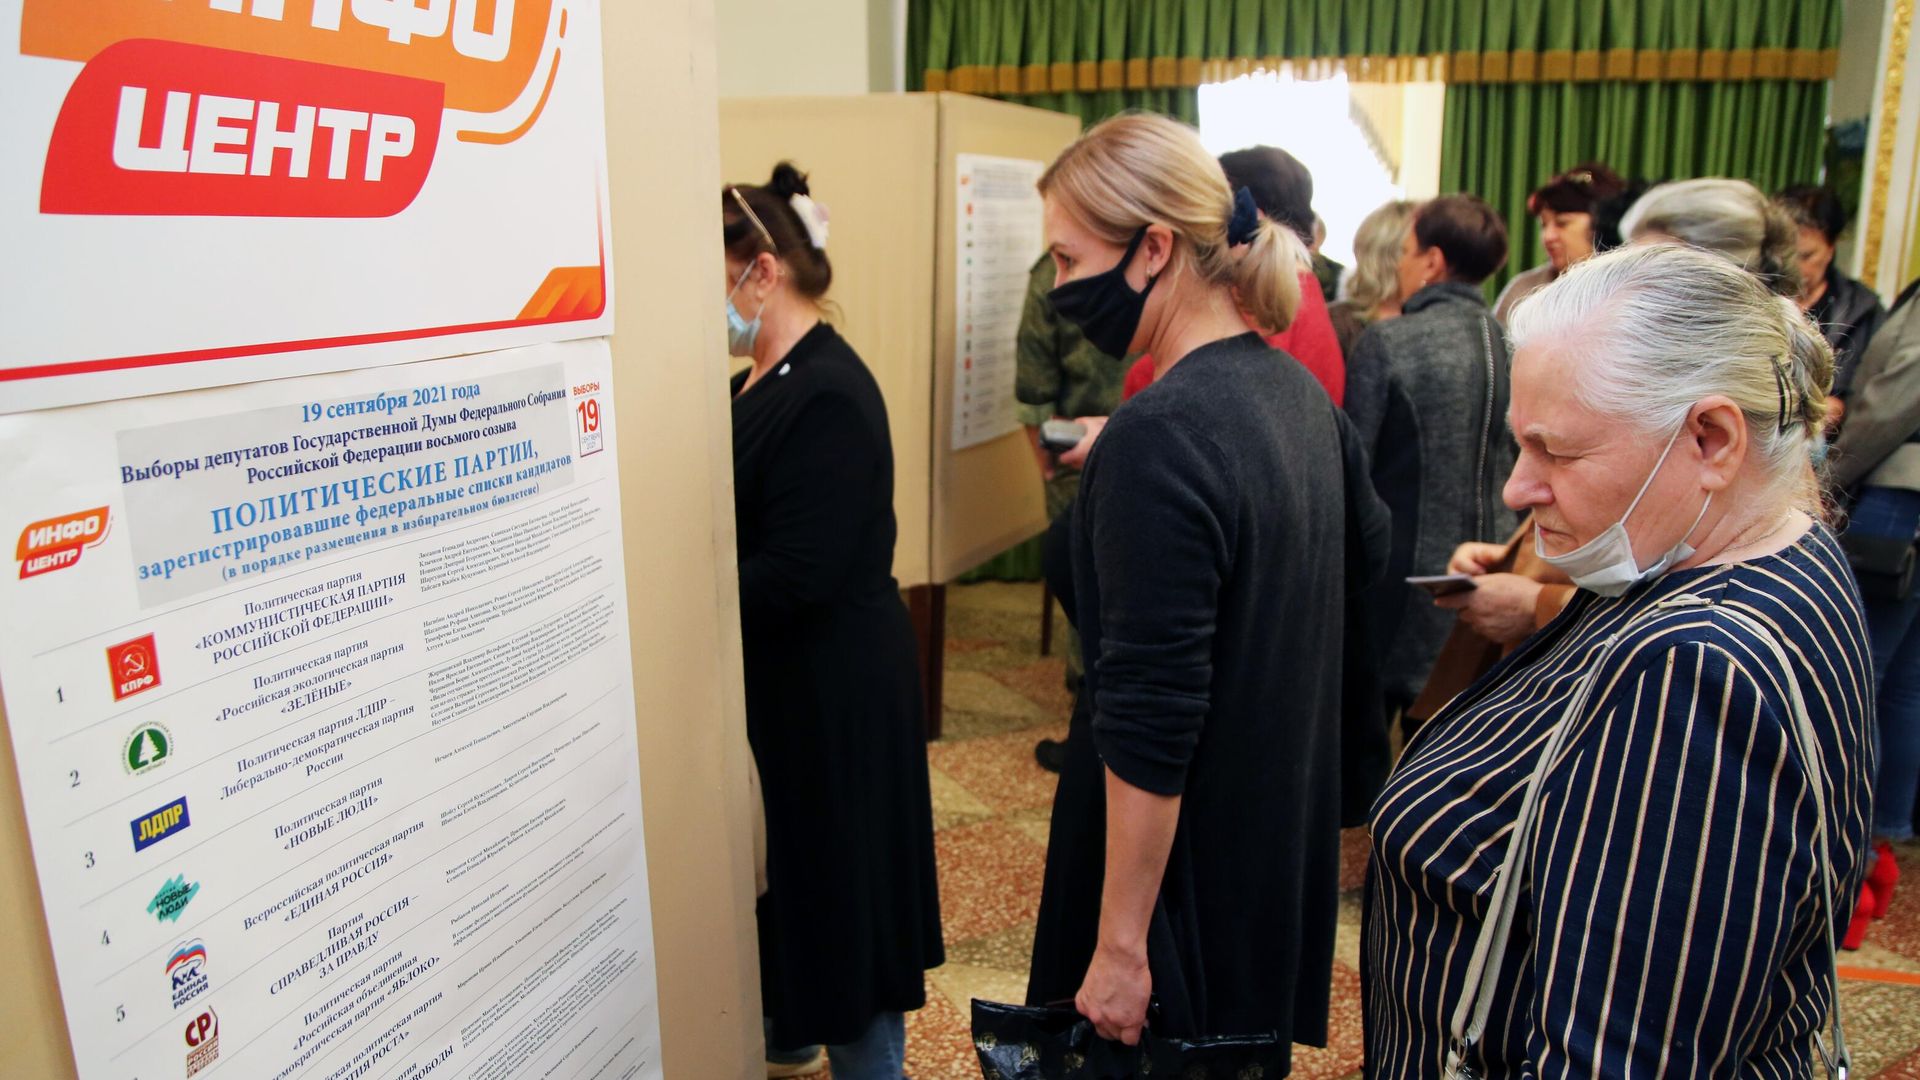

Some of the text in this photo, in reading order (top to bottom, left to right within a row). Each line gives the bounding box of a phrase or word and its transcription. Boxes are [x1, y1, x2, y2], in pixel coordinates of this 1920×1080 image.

[112, 85, 416, 181] ЦЕНТР
[302, 383, 481, 423] 19 сентября 2021 года
[573, 382, 600, 396] ВЫБОРЫ
[121, 389, 566, 484] Выборы депутатов Государственной Думы Федерального Собрания
[578, 399, 599, 433] 19
[247, 421, 517, 484] Российской Федерации восьмого созыва
[211, 461, 447, 534] ПОЛИТИЧЕСКИЕ
[454, 439, 539, 478] ПАРТИИ,
[28, 515, 100, 549] ИНФО
[138, 512, 351, 580] зарегистрировавшие
[356, 486, 465, 526] федеральные
[468, 475, 513, 496] списки
[516, 455, 572, 482] кандидатов
[26, 549, 79, 573] ЦЕНТР
[222, 566, 236, 582] (в
[242, 547, 301, 573] порядке
[305, 526, 387, 561] размещения
[391, 523, 399, 534] в
[402, 500, 490, 533] избирательном
[195, 573, 406, 650] «КОММУНИСТИЧЕСКАЯ ПАРТИЯ
[244, 572, 362, 617] Политическая партия
[213, 595, 394, 664] РОССИЙСКОЙ ФЕДЕРАЦИИ»
[121, 674, 154, 695] КПРФ
[215, 643, 405, 722] «Российская экологическая партия
[253, 640, 369, 690] Политическая партия
[56, 687, 64, 703] 1
[281, 679, 352, 714] «ЗЕЛЁНЫЕ»
[220, 720, 380, 800] Либерально-демократическая
[382, 704, 415, 726] партия
[237, 698, 387, 773] Политическая партия ЛДПР
[70, 770, 80, 788] 2
[305, 753, 344, 777] России
[139, 803, 184, 842] ЛДПР
[274, 777, 383, 839] Политическая партия
[284, 795, 379, 850] «НОВЫЕ ЛЮДИ»
[85, 851, 95, 868] 3
[243, 820, 425, 931] Всероссийская политическая партия
[156, 883, 192, 909] НОВЫЕ
[158, 896, 189, 920] ЛЮДИ
[284, 853, 393, 922] «ЕДИНАЯ РОССИЯ»
[101, 930, 111, 946] 4
[269, 924, 362, 996] СПРАВЕДЛИВАЯ
[364, 896, 410, 931] РОССИЯ
[327, 912, 364, 941] Партия
[318, 931, 380, 979] ЗА ПРАВДУ
[172, 974, 208, 1001] ЕДИНАЯ
[173, 983, 209, 1009] РОССИЯ
[293, 955, 418, 1051] «Российская объединенная
[304, 951, 403, 1027] Политическая партия
[116, 1004, 126, 1022] 5
[185, 1012, 212, 1047] СР
[272, 956, 440, 1080] емократическая партия «ЯБЛОКО»
[352, 1013, 412, 1065] политическая
[413, 990, 444, 1018] партия
[372, 1031, 410, 1065] РОСТА»
